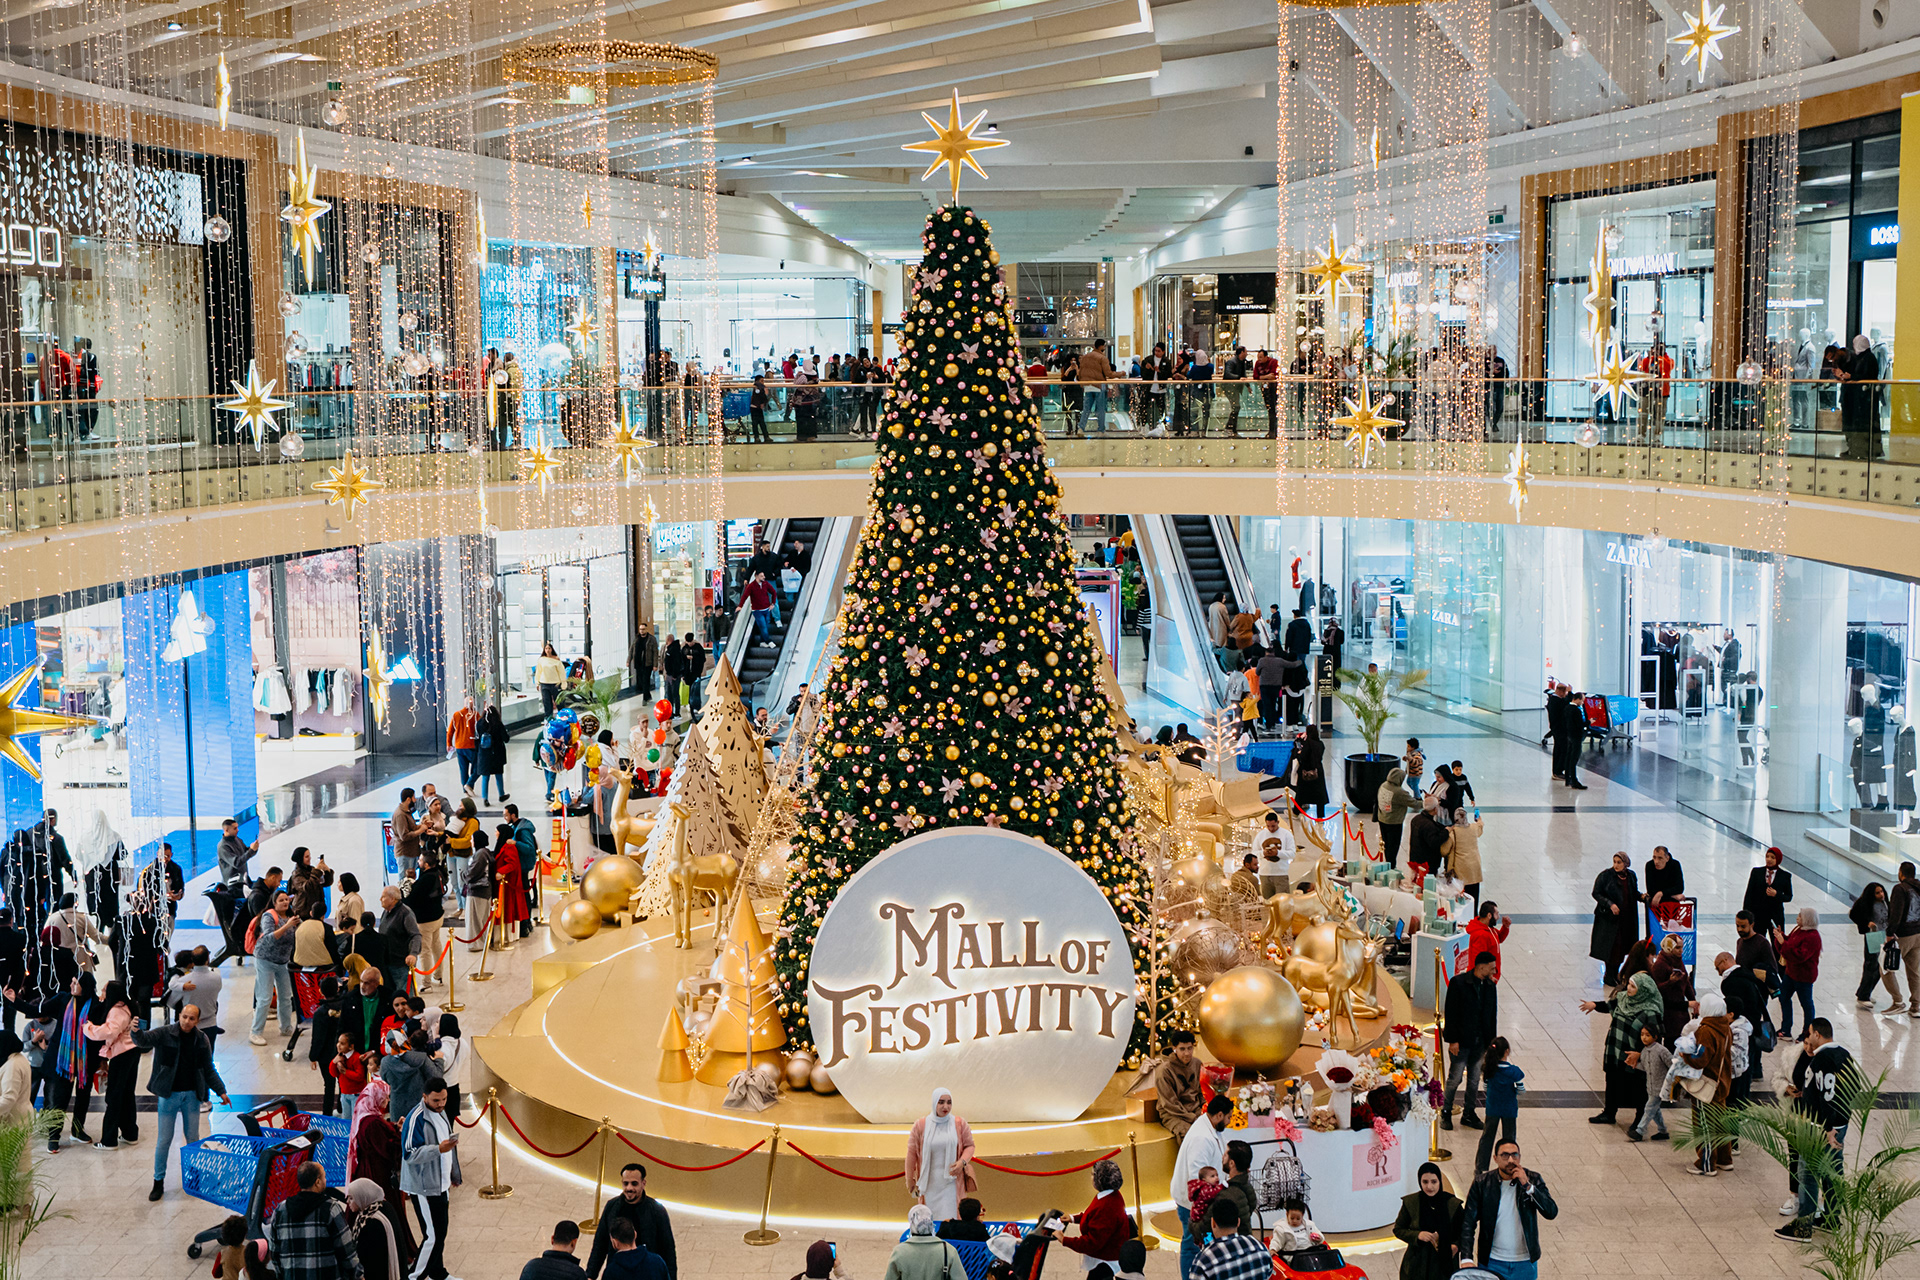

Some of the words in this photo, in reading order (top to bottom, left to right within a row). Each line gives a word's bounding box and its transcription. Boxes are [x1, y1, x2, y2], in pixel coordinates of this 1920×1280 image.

[1871, 225, 1899, 245] BOSS
[1640, 252, 1675, 275] ARMANI
[1606, 541, 1653, 569] ZARA
[1431, 609, 1460, 627] ZARA
[879, 902, 1056, 990] MALL
[1059, 939, 1111, 975] OF
[812, 979, 1129, 1068] FESTIVITY
